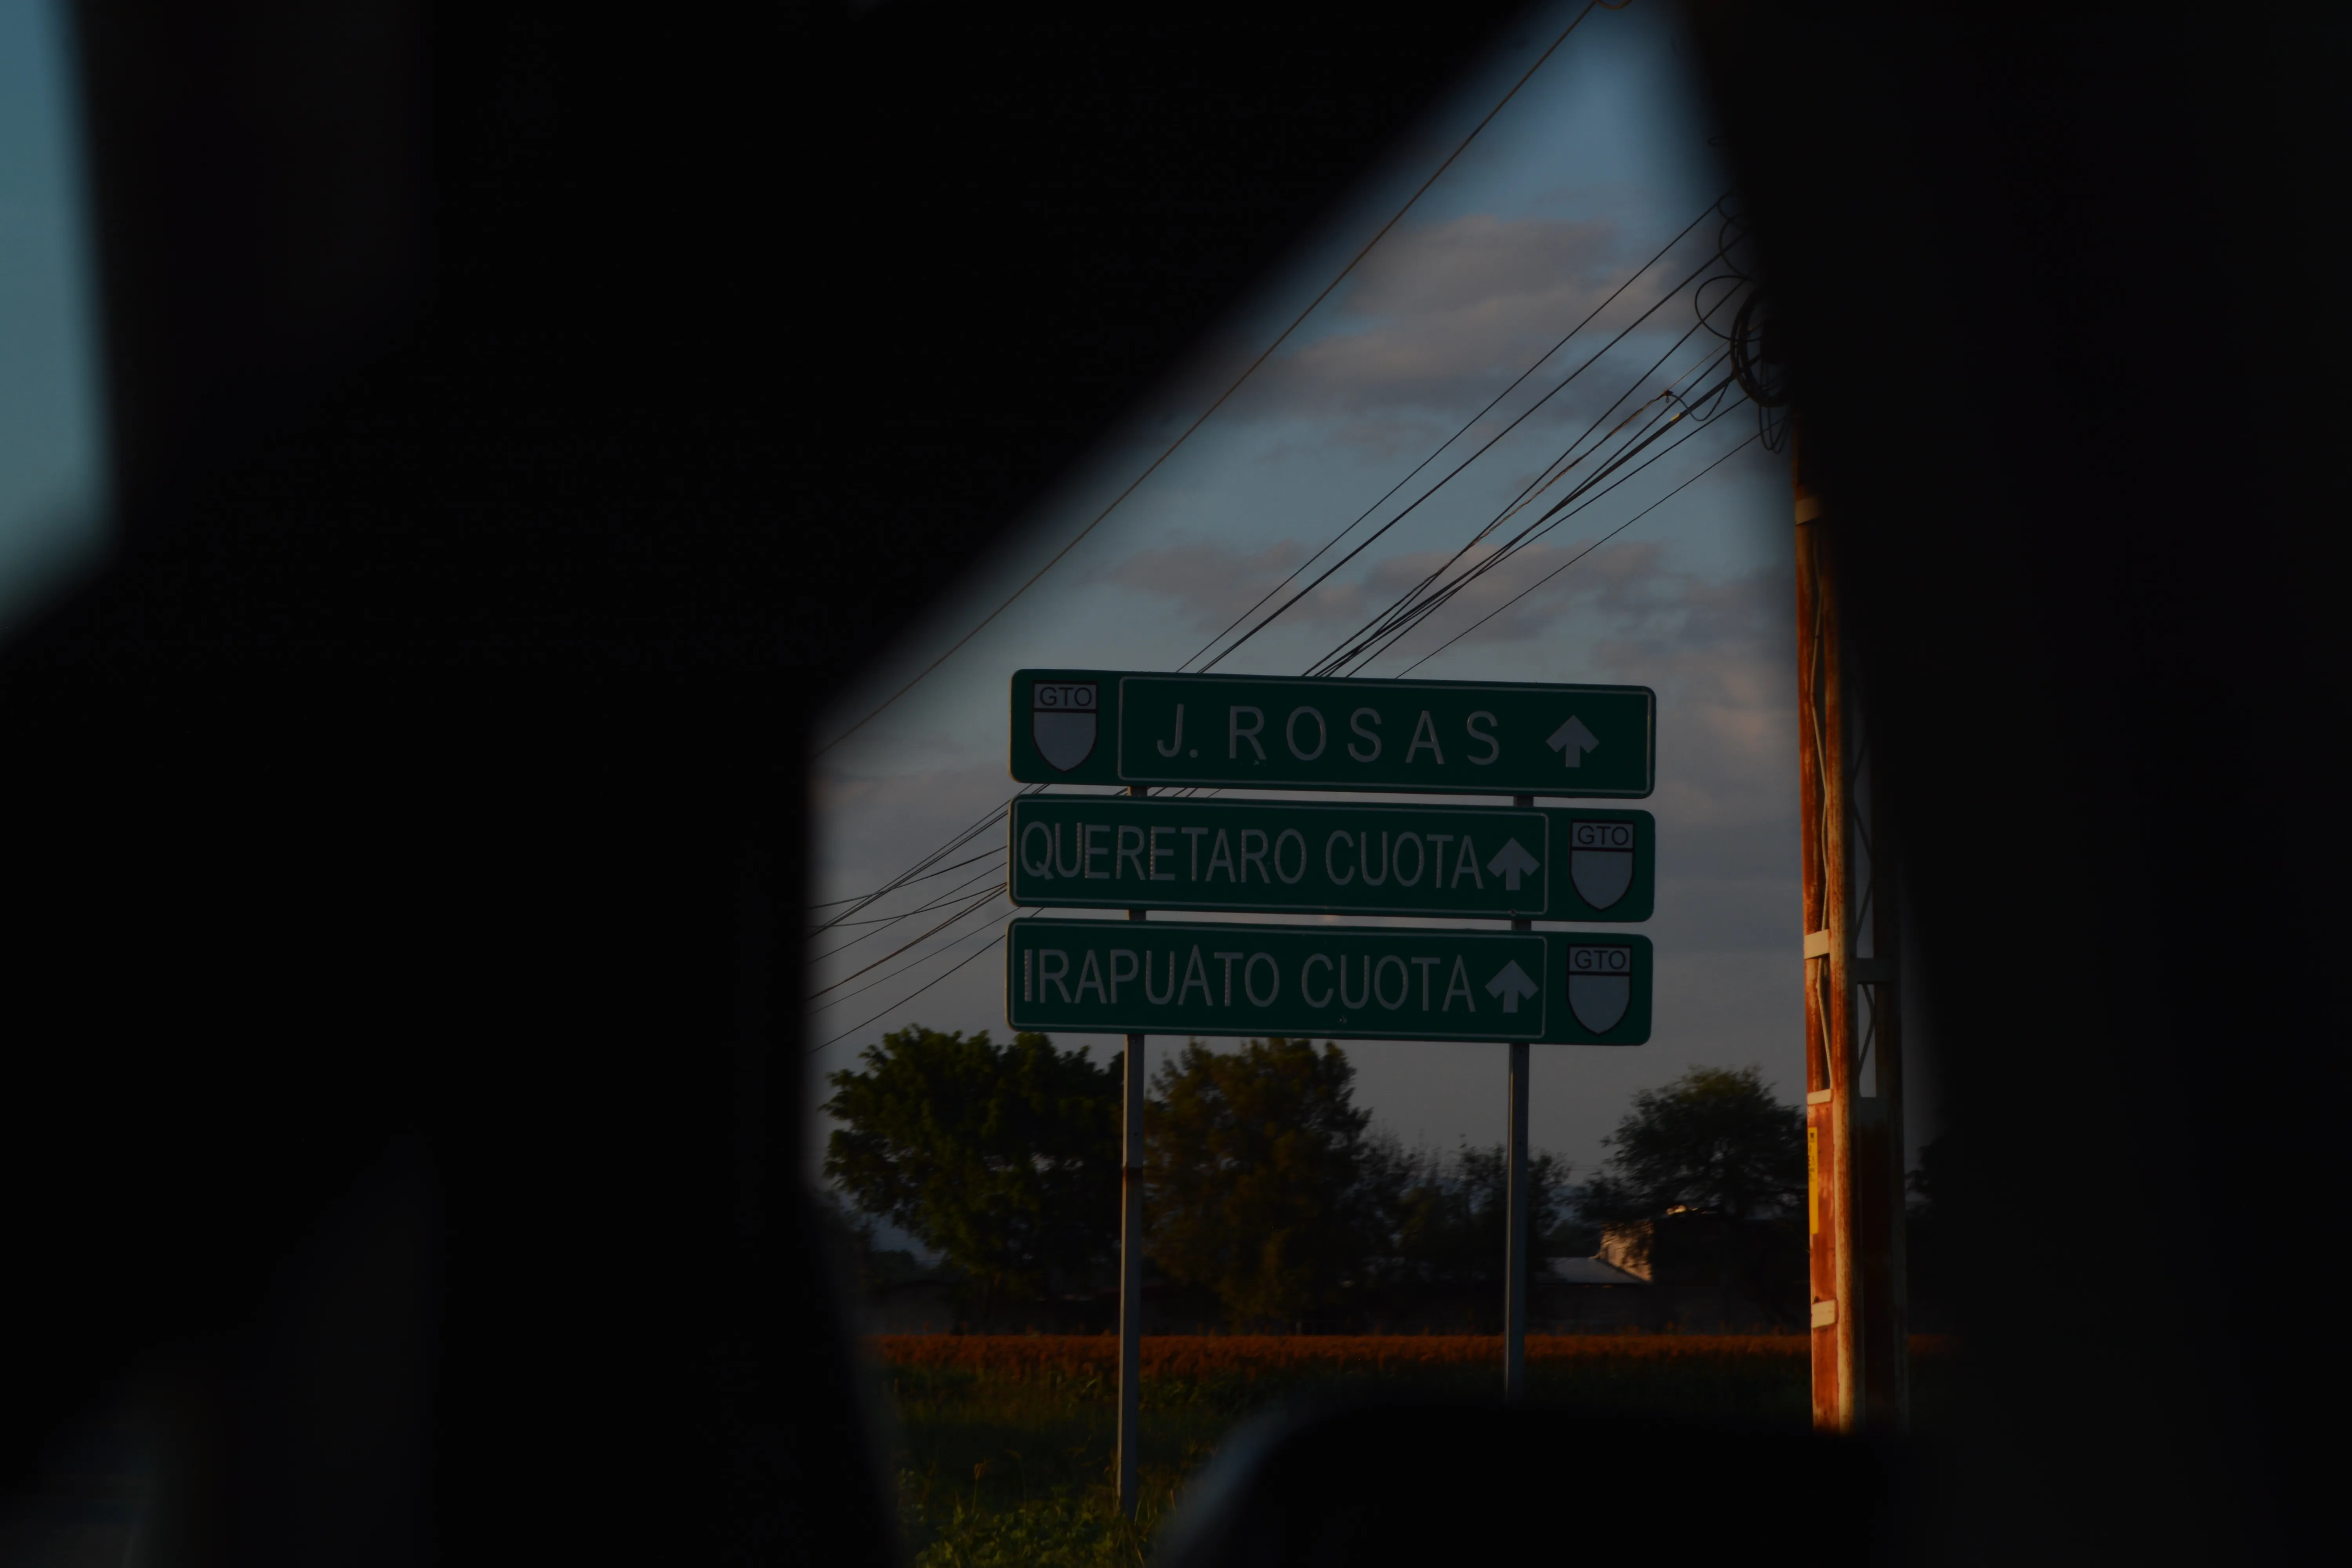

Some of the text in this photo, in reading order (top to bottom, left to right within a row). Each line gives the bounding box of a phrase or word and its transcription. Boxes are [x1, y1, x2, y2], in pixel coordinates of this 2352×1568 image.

[1039, 687, 1092, 706] GTO
[1156, 703, 1501, 765] J. ROSAS
[1020, 821, 1484, 889] QUERETARO CUOTA
[1577, 826, 1629, 845] GTO
[1024, 944, 1477, 1012] IRAPUATO CUOTA
[1574, 950, 1626, 970] GTO
